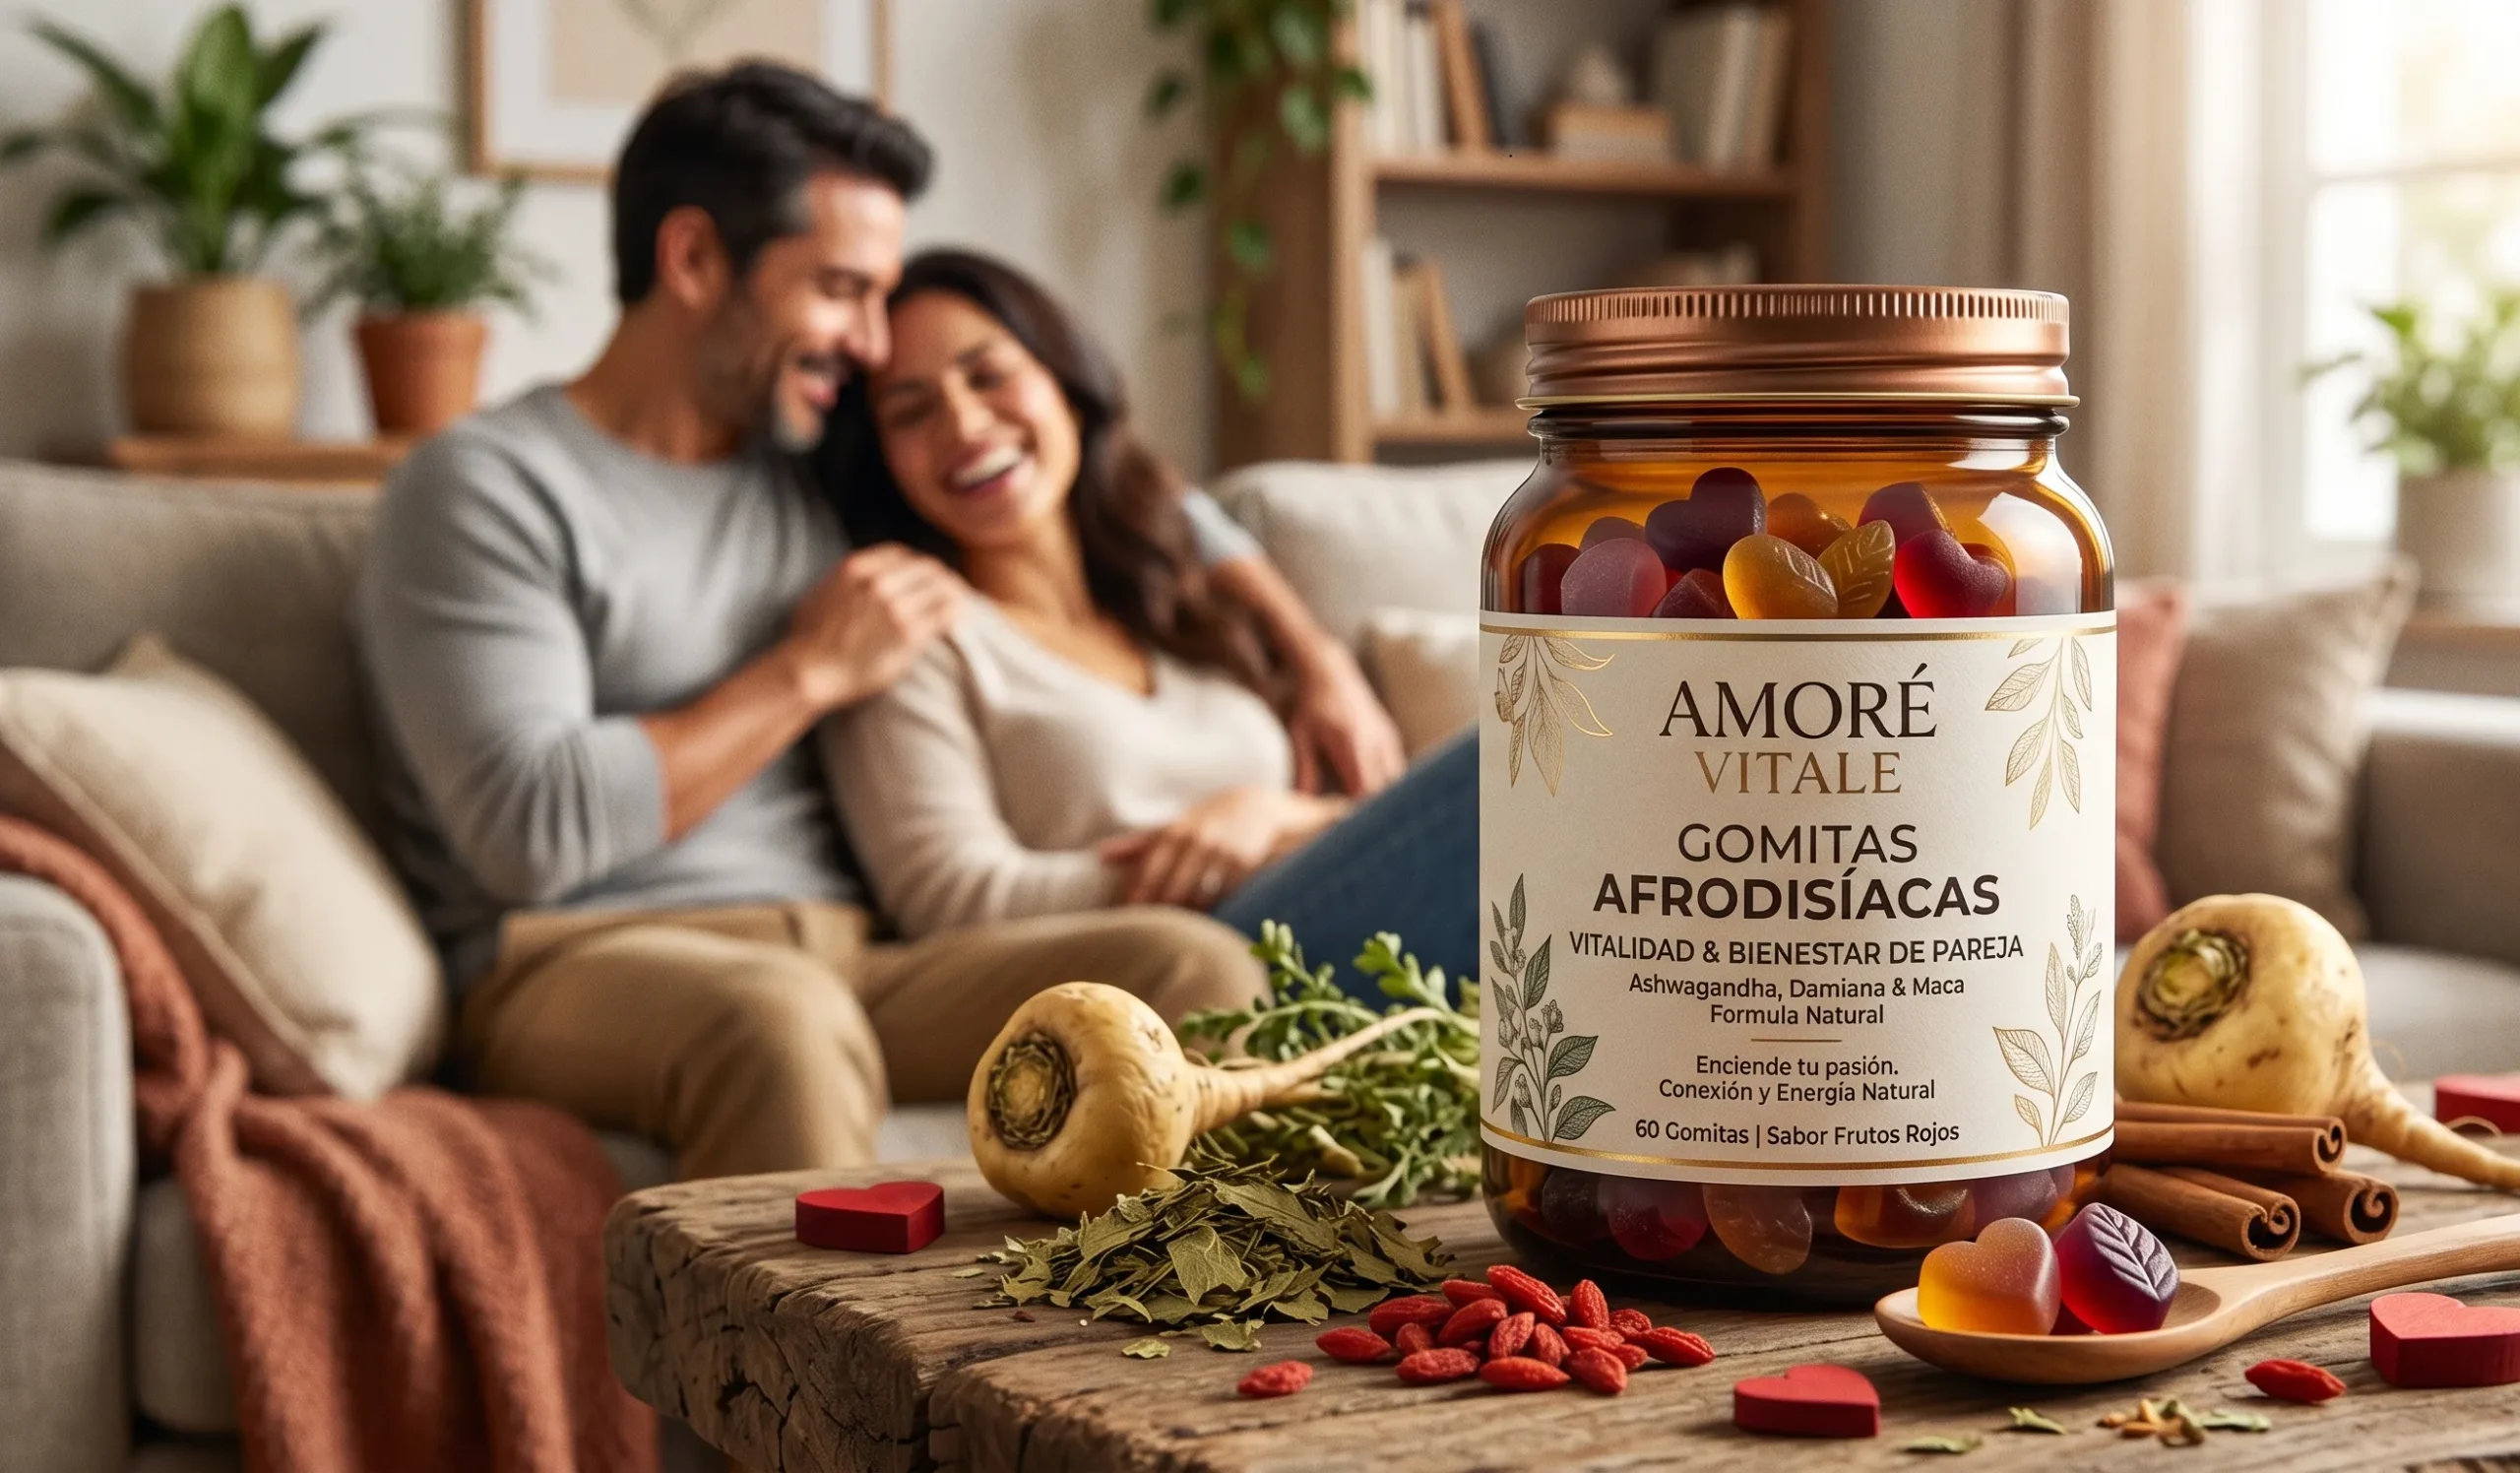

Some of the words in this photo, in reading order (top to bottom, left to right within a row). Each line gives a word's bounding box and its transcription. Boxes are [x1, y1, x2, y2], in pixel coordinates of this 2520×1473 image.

[1658, 662, 1938, 738] AMORÉ
[1694, 750, 1902, 794] VITALE
[1677, 822, 1919, 864] GOMITAS
[1592, 866, 2000, 921] AFRODISÍACAS
[1568, 931, 1695, 962] VITALIDAD
[1702, 940, 1721, 963] &
[1729, 941, 1881, 965] BIENESTAR
[1889, 940, 1925, 964] DE
[1932, 934, 2025, 962] PAREJA
[1628, 973, 1783, 1001] Ashwagandha,
[1790, 978, 1885, 997] Damiana
[1891, 978, 1907, 996] &
[1913, 977, 1965, 995] Maca
[1710, 1004, 1798, 1024] Formula
[1806, 1004, 1884, 1024] Natural
[1696, 1056, 1793, 1075] Enciende
[1796, 1058, 1819, 1075] tu
[1825, 1056, 1899, 1080] pasión.
[1659, 1079, 1753, 1100] Conexión
[1757, 1087, 1771, 1105] y
[1777, 1081, 1856, 1106] Energía
[1862, 1079, 1935, 1101] Natural
[1635, 1120, 1661, 1138] 60
[1665, 1121, 1750, 1144] Gomitas
[1767, 1125, 1829, 1145] Sabor
[1834, 1126, 1901, 1145] Frutos
[1906, 1121, 1960, 1146] Rojos
